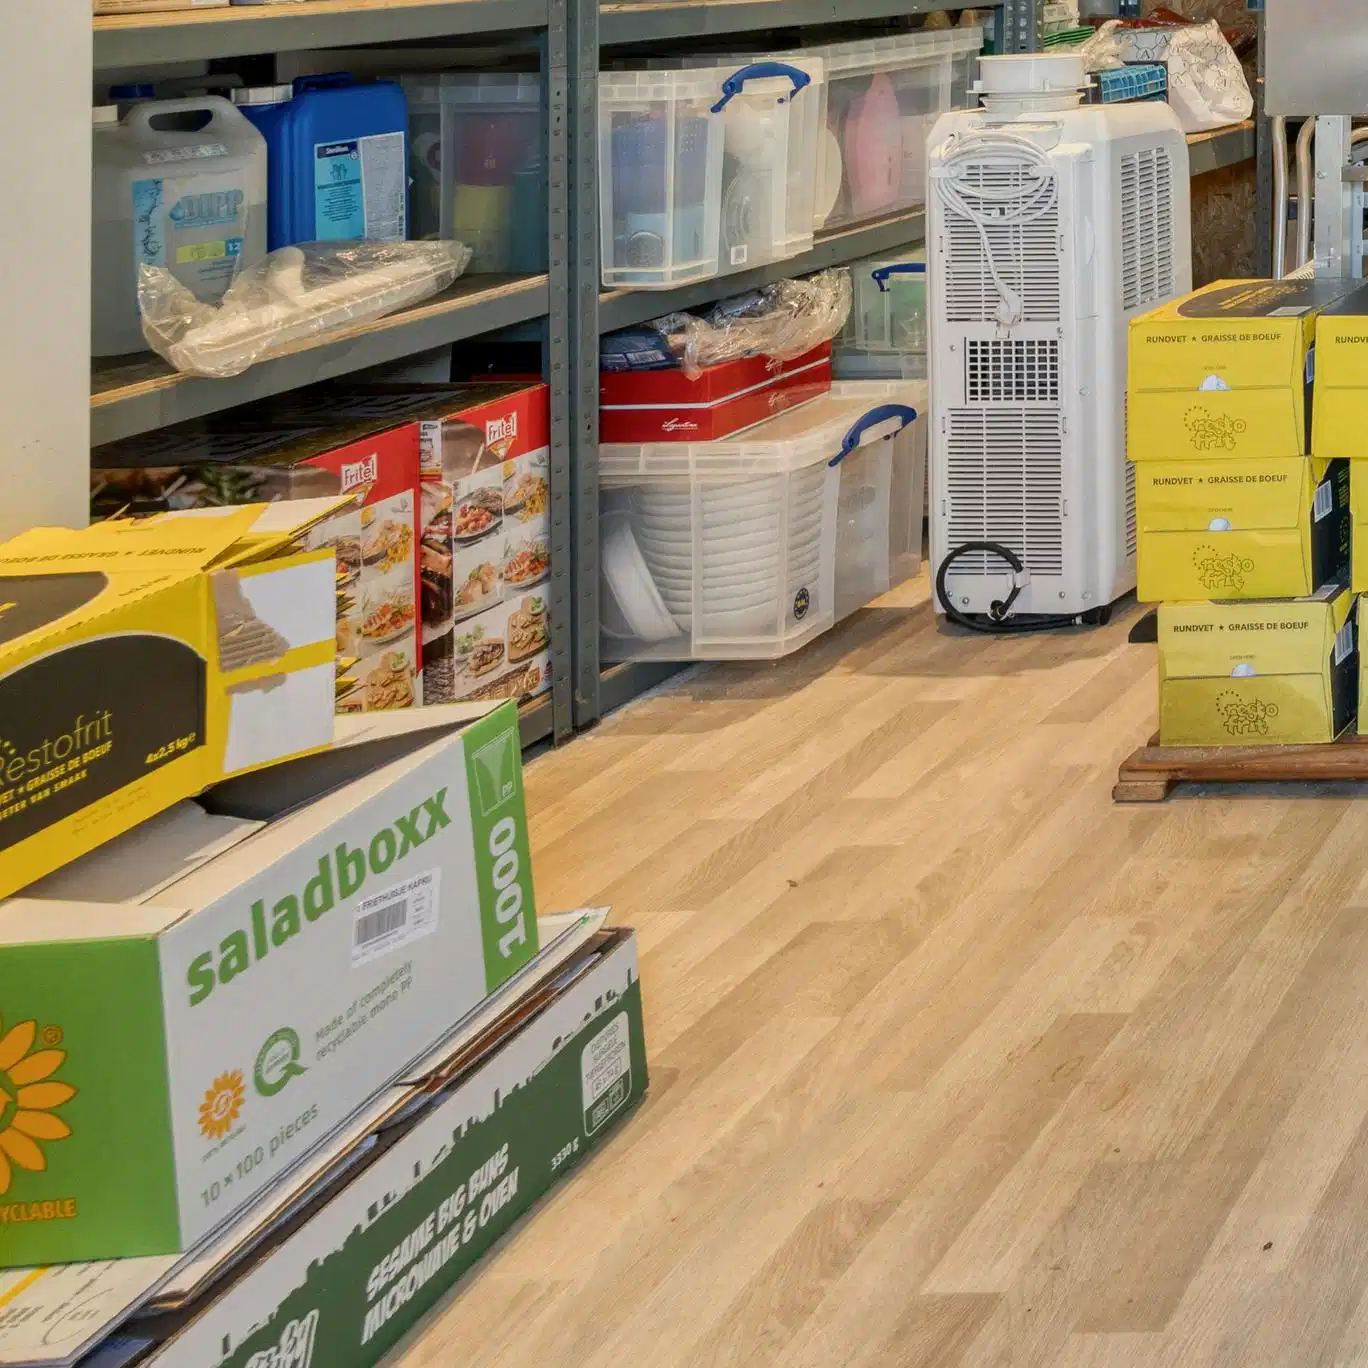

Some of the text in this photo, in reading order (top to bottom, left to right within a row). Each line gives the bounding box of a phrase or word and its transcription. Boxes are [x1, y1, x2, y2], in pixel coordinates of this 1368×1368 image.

[1146, 335, 1186, 344] RUNDVET
[1201, 333, 1237, 342] GRAISSE
[1252, 333, 1281, 341] BOEUF
[488, 413, 516, 441] Fritel
[344, 458, 376, 486] Fritel
[1152, 474, 1288, 486] RUNDVET GRAISSE DE BOEUF
[1173, 621, 1309, 633] RUNDVET GRAISSE DE BOEUF
[67, 756, 81, 771] DE
[82, 740, 113, 764] BOEUF
[187, 786, 452, 1007] saladboxx
[489, 817, 527, 958] 1000
[315, 960, 414, 1042] Made of completely
[316, 976, 413, 1061] recyclable mono PP
[200, 1182, 221, 1207] 10
[235, 1146, 264, 1181] 100
[269, 1103, 318, 1157] pieces
[0, 1198, 77, 1222] YCLABLE
[366, 1143, 510, 1302] SESAME BIG BUNS
[361, 1166, 520, 1346] MICROWAVE & OVEN
